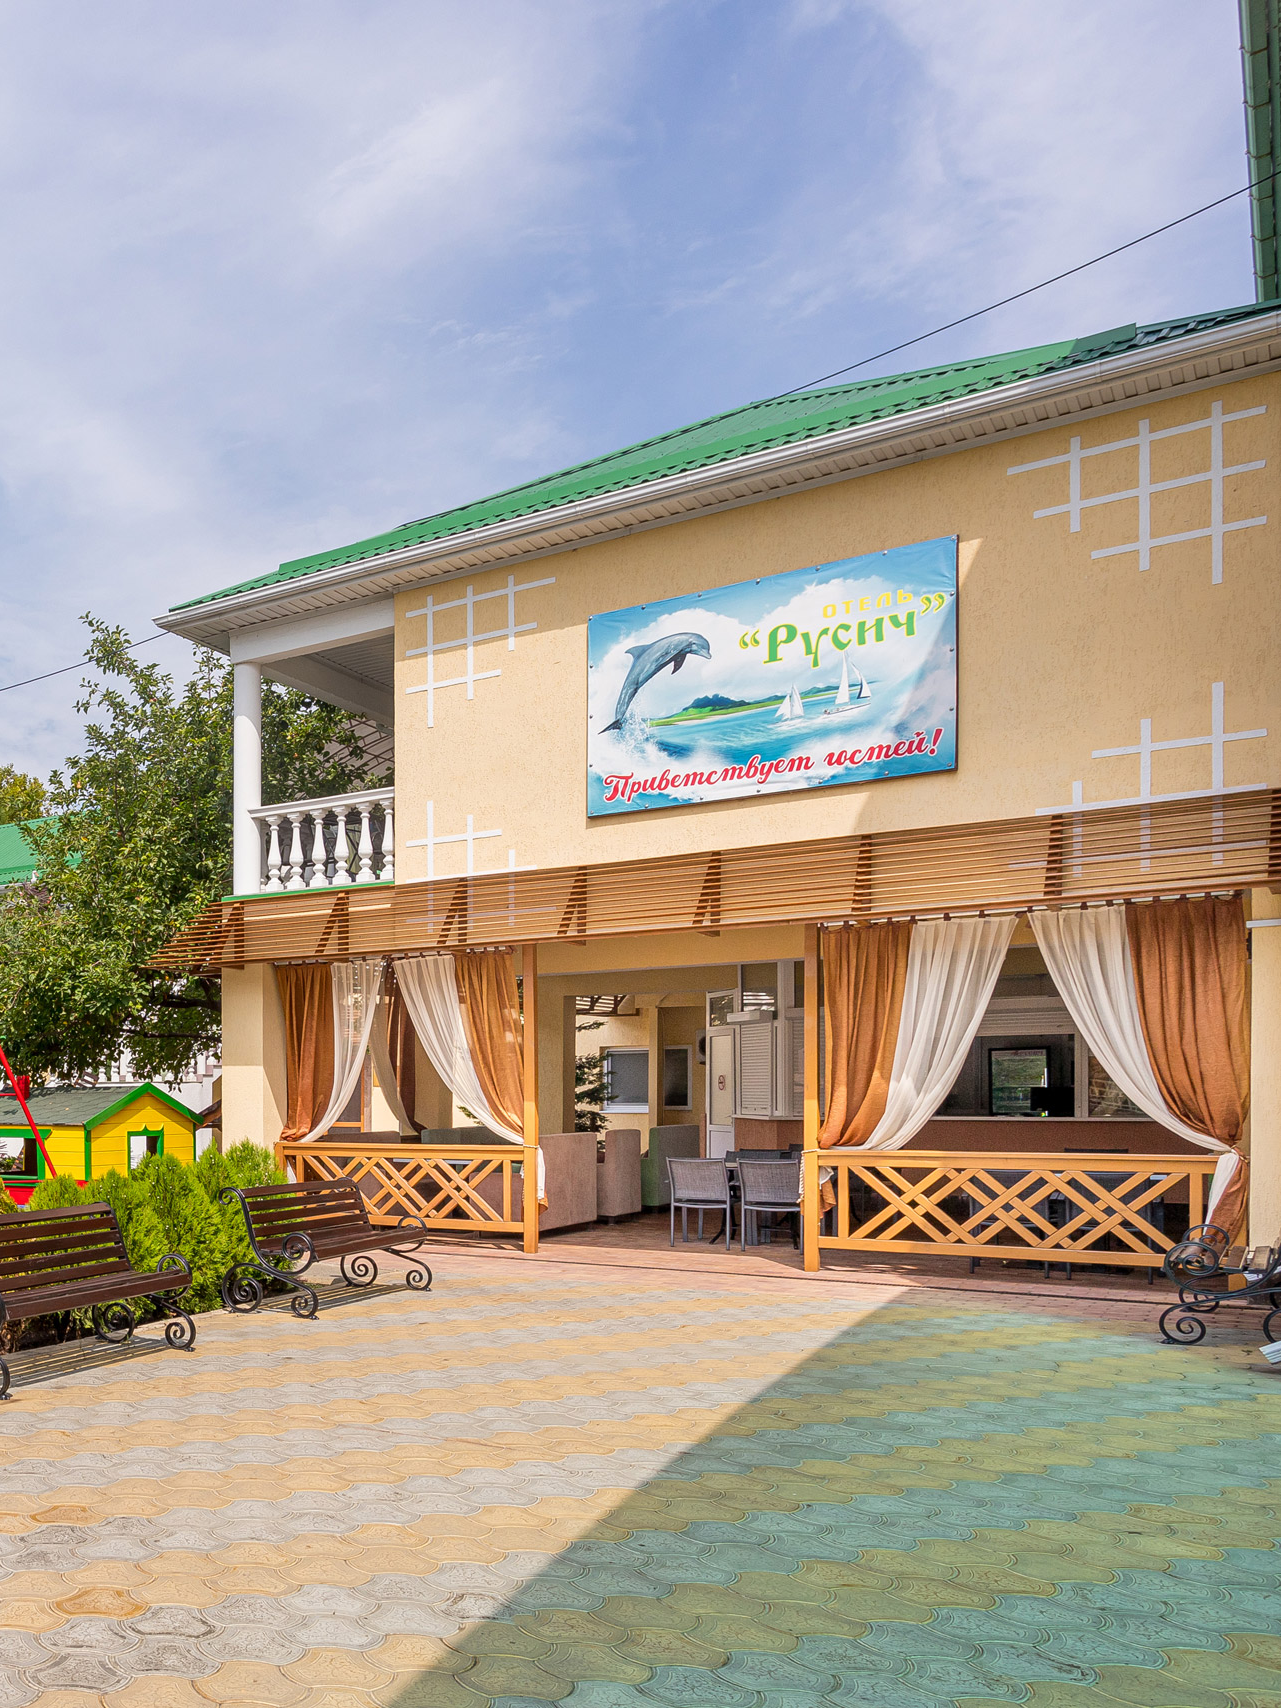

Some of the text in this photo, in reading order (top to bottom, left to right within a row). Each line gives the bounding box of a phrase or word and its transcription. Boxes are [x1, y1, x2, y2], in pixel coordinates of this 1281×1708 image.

[822, 590, 914, 618] ОТЕЛЬ
[604, 728, 944, 803] Приветствует гостей!
